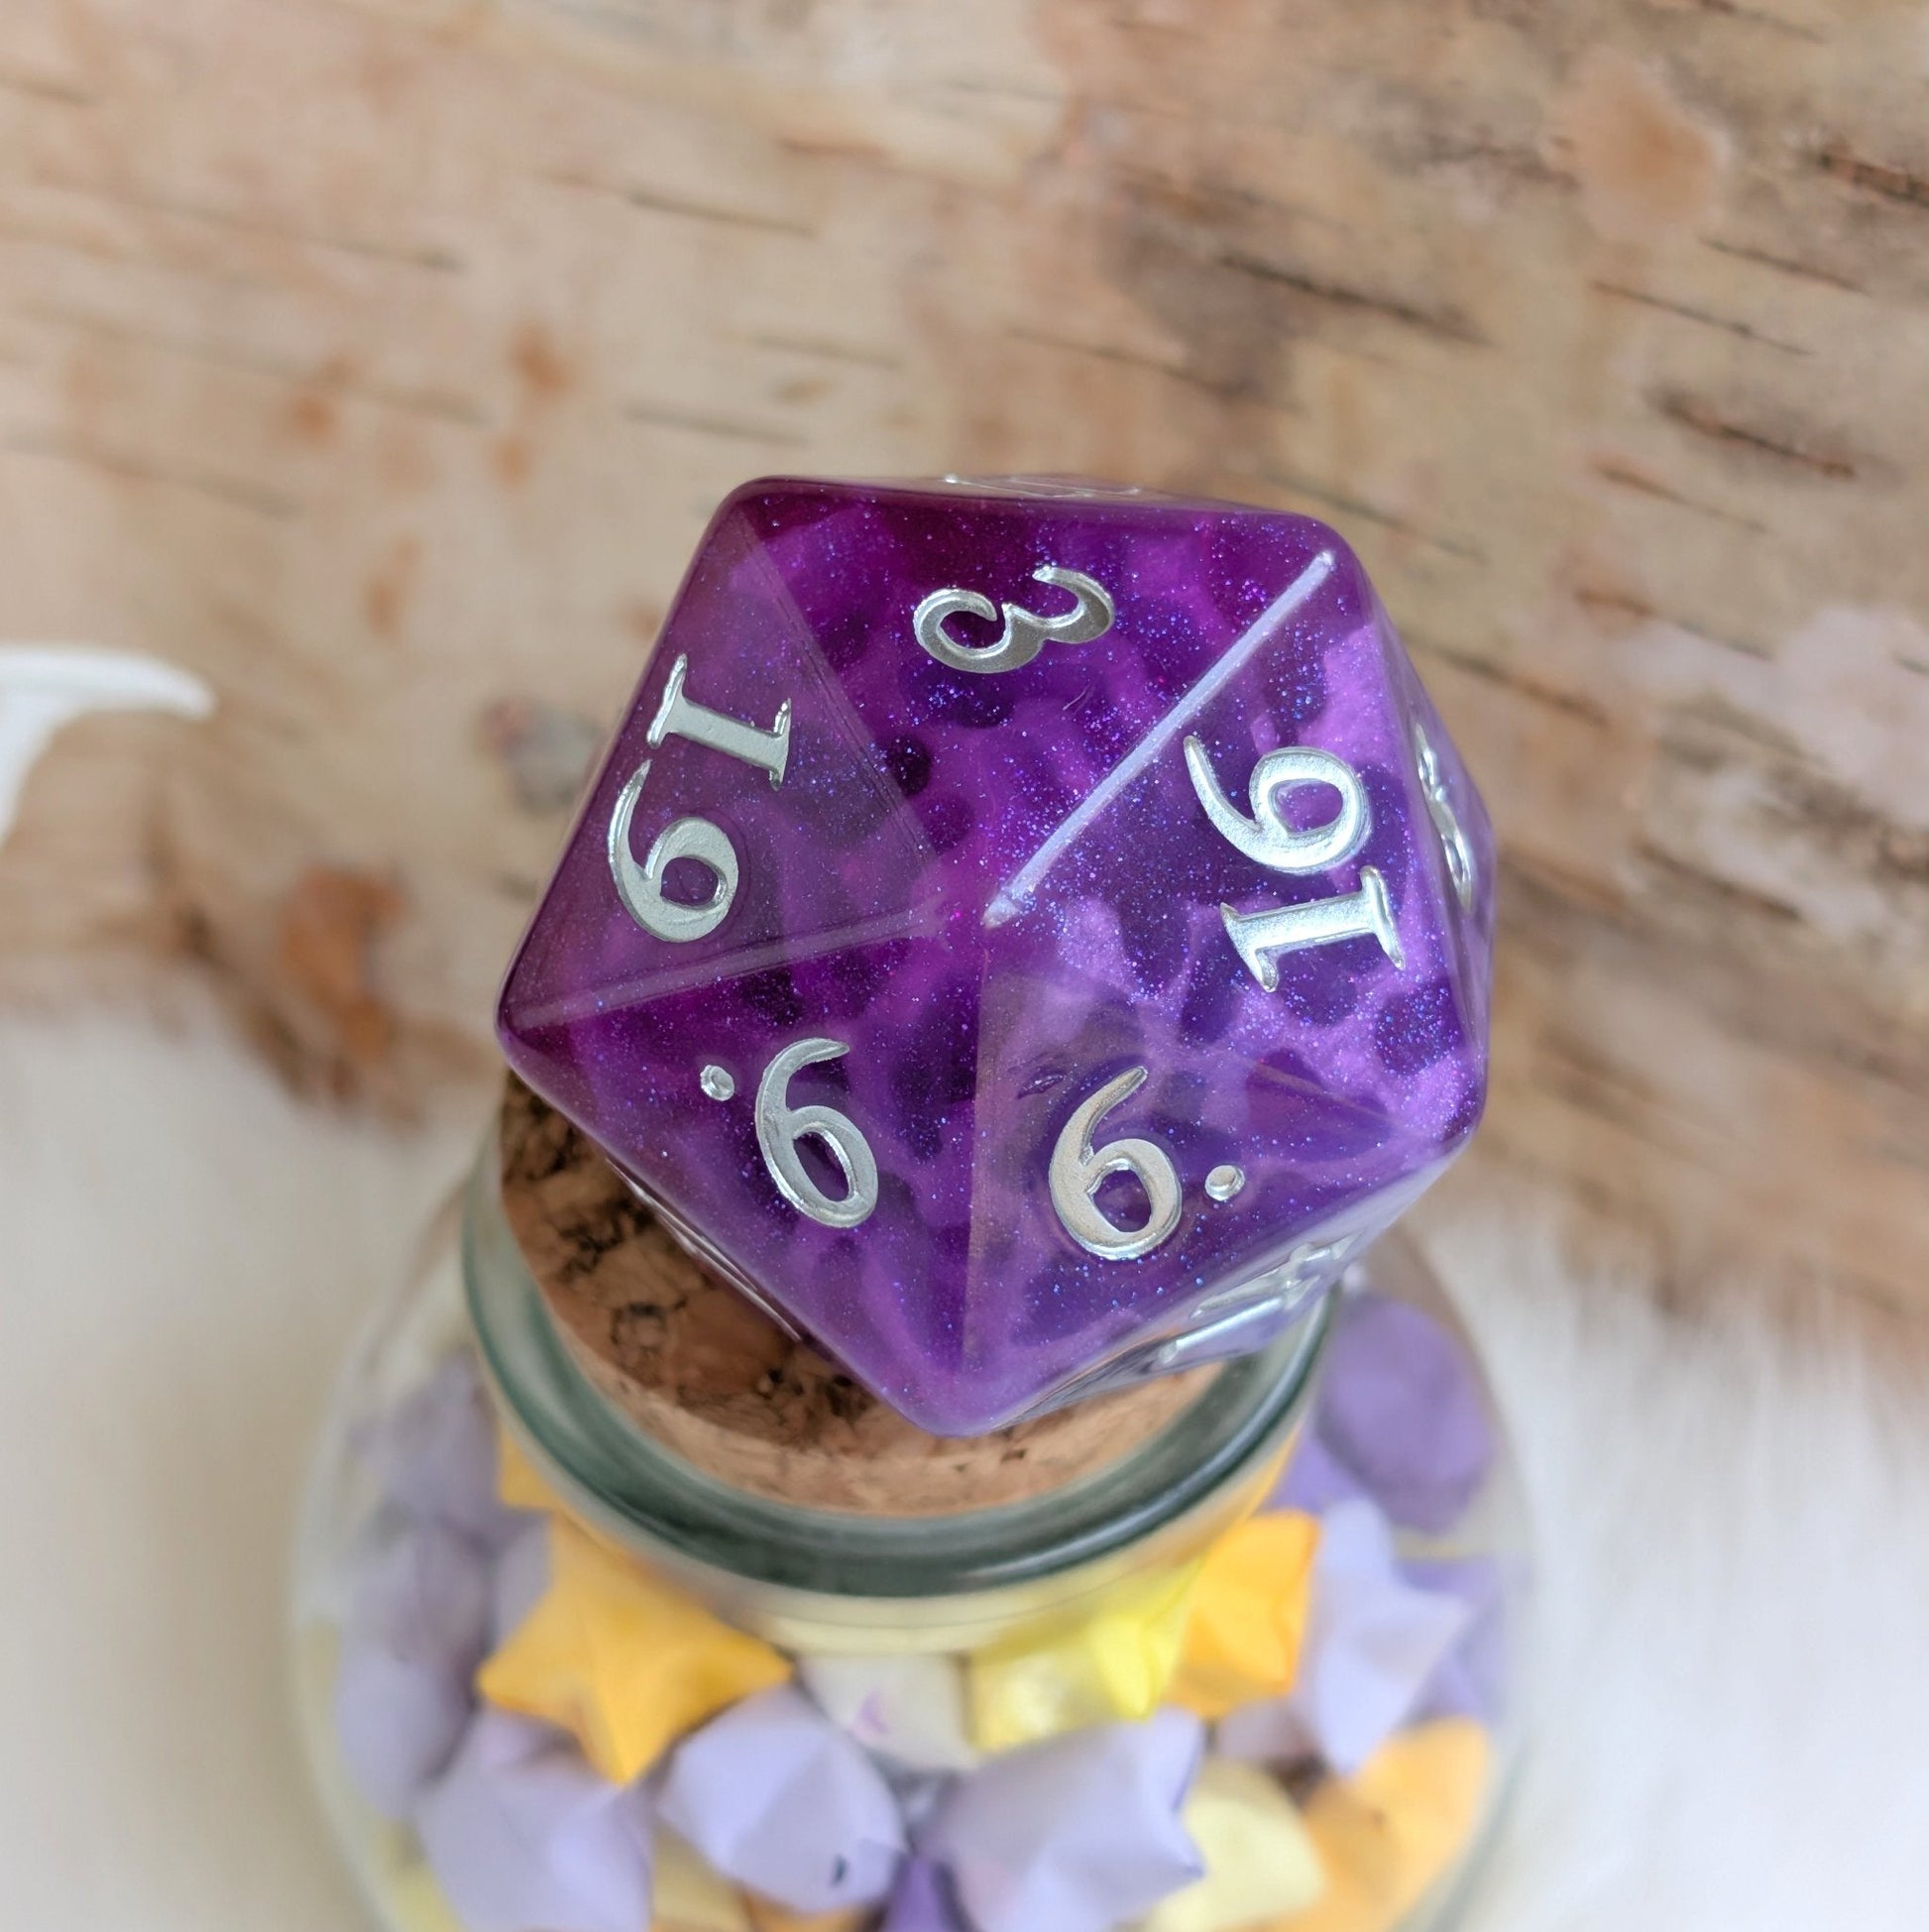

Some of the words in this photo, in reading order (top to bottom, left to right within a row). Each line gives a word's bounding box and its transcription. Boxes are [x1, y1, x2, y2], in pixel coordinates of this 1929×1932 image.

[913, 564, 1115, 674] 3
[607, 652, 791, 943] 19
[1183, 735, 1406, 993] 16
